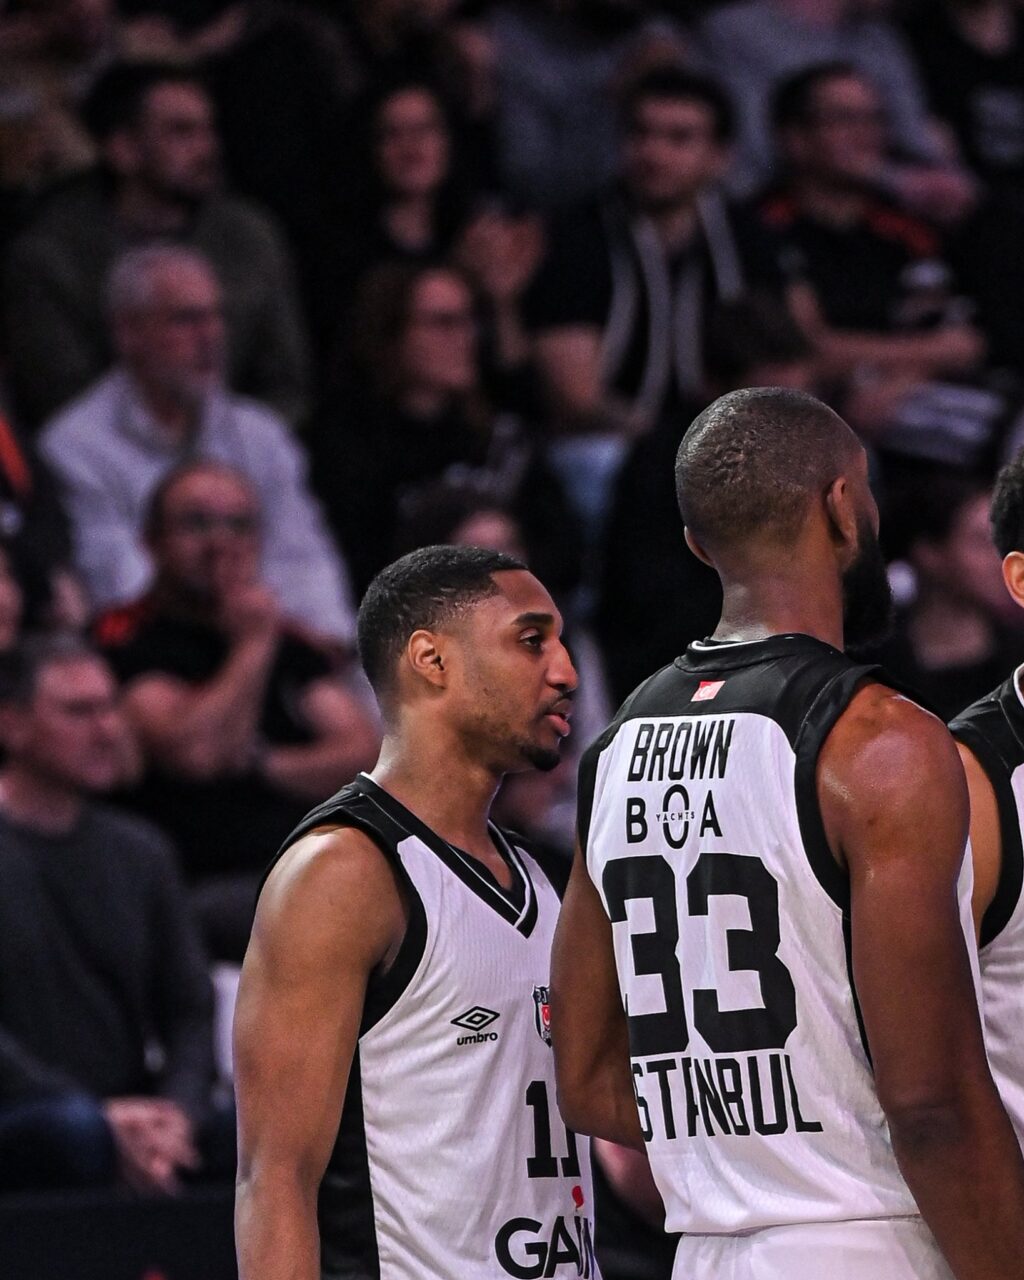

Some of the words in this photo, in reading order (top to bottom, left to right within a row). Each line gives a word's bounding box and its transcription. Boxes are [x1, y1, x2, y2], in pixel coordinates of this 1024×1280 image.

[627, 719, 736, 782] BROWN
[626, 784, 723, 850] BOA
[656, 811, 695, 822] YACHTS
[602, 852, 798, 1057] 33
[456, 1031, 498, 1046] umbro
